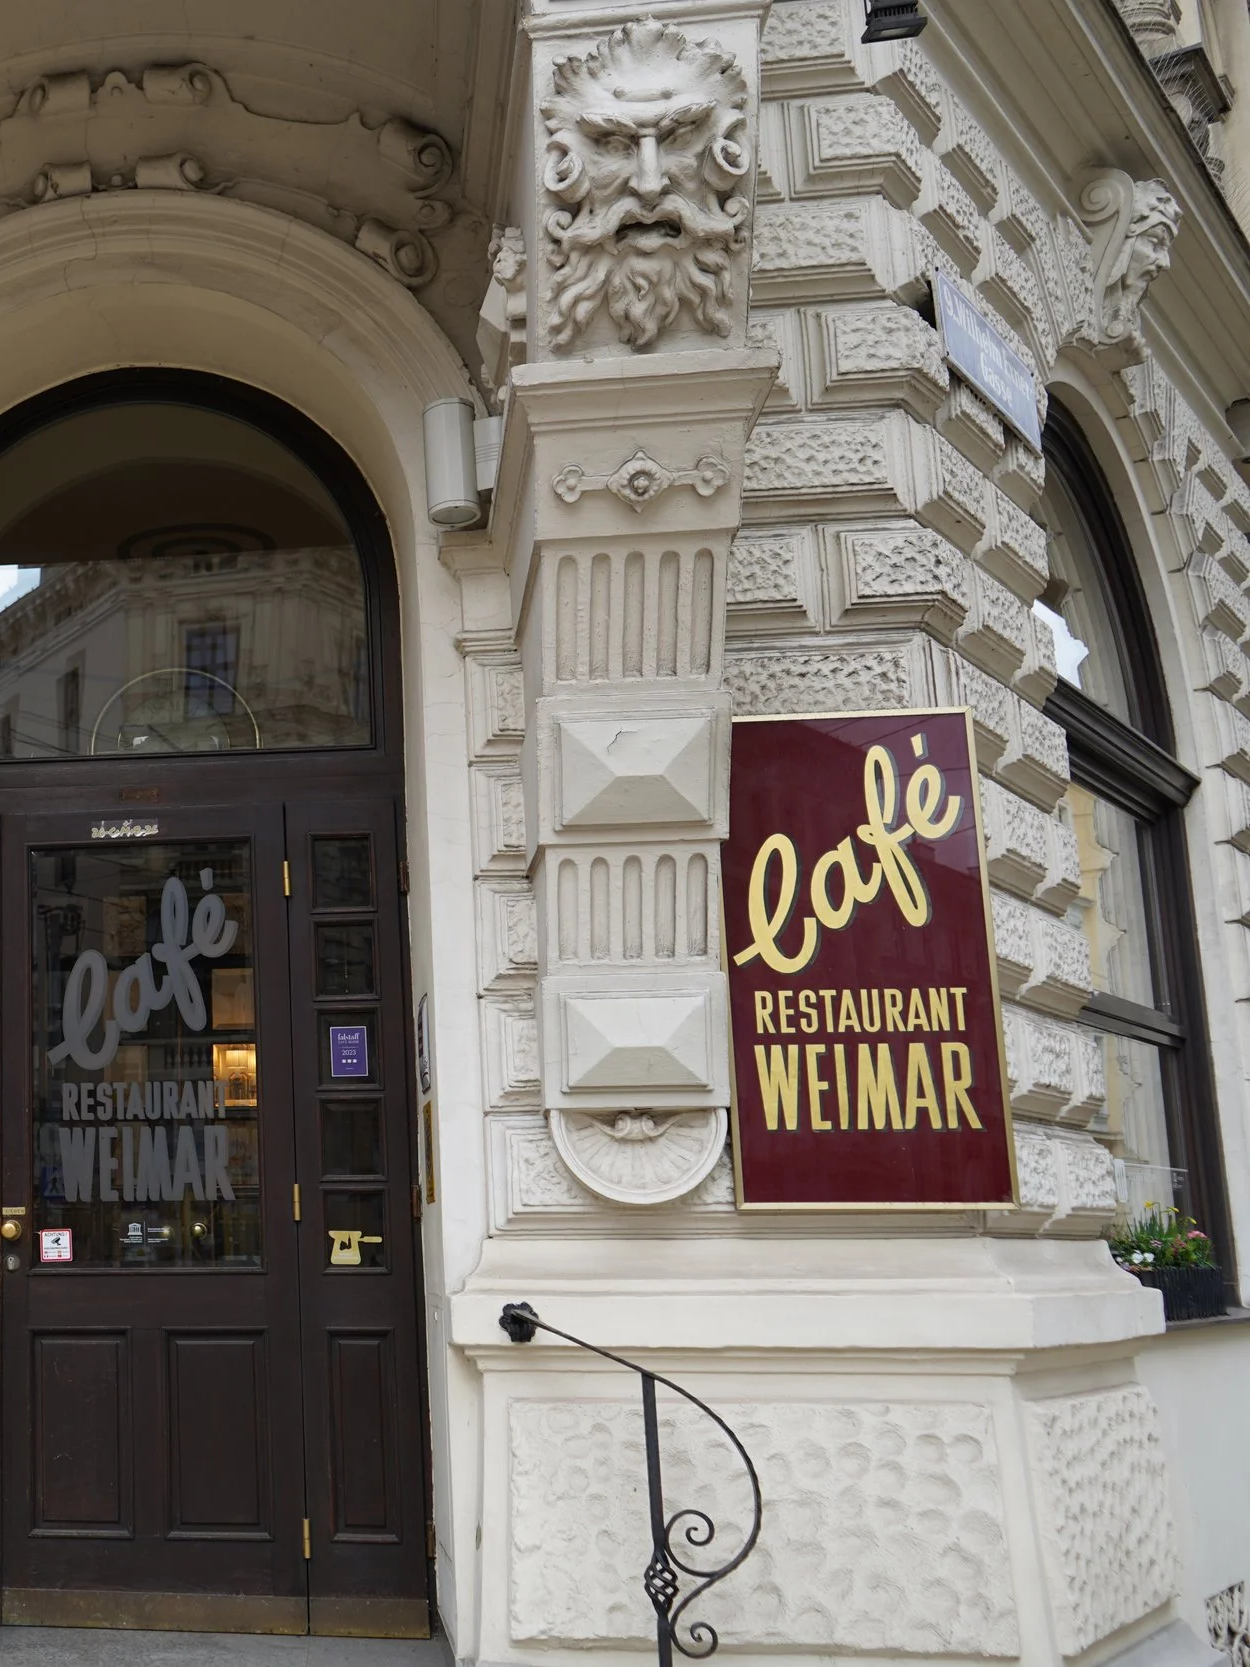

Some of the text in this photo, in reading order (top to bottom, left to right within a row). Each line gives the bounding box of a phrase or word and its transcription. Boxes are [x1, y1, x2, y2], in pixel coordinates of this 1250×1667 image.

[733, 733, 961, 975] Café
[47, 868, 239, 1071] Café
[754, 987, 968, 1034] RESTAURANT
[62, 1080, 227, 1121] RESTAURANT
[754, 1042, 984, 1132] WEIMAR
[59, 1125, 237, 1202] WEIMAR
